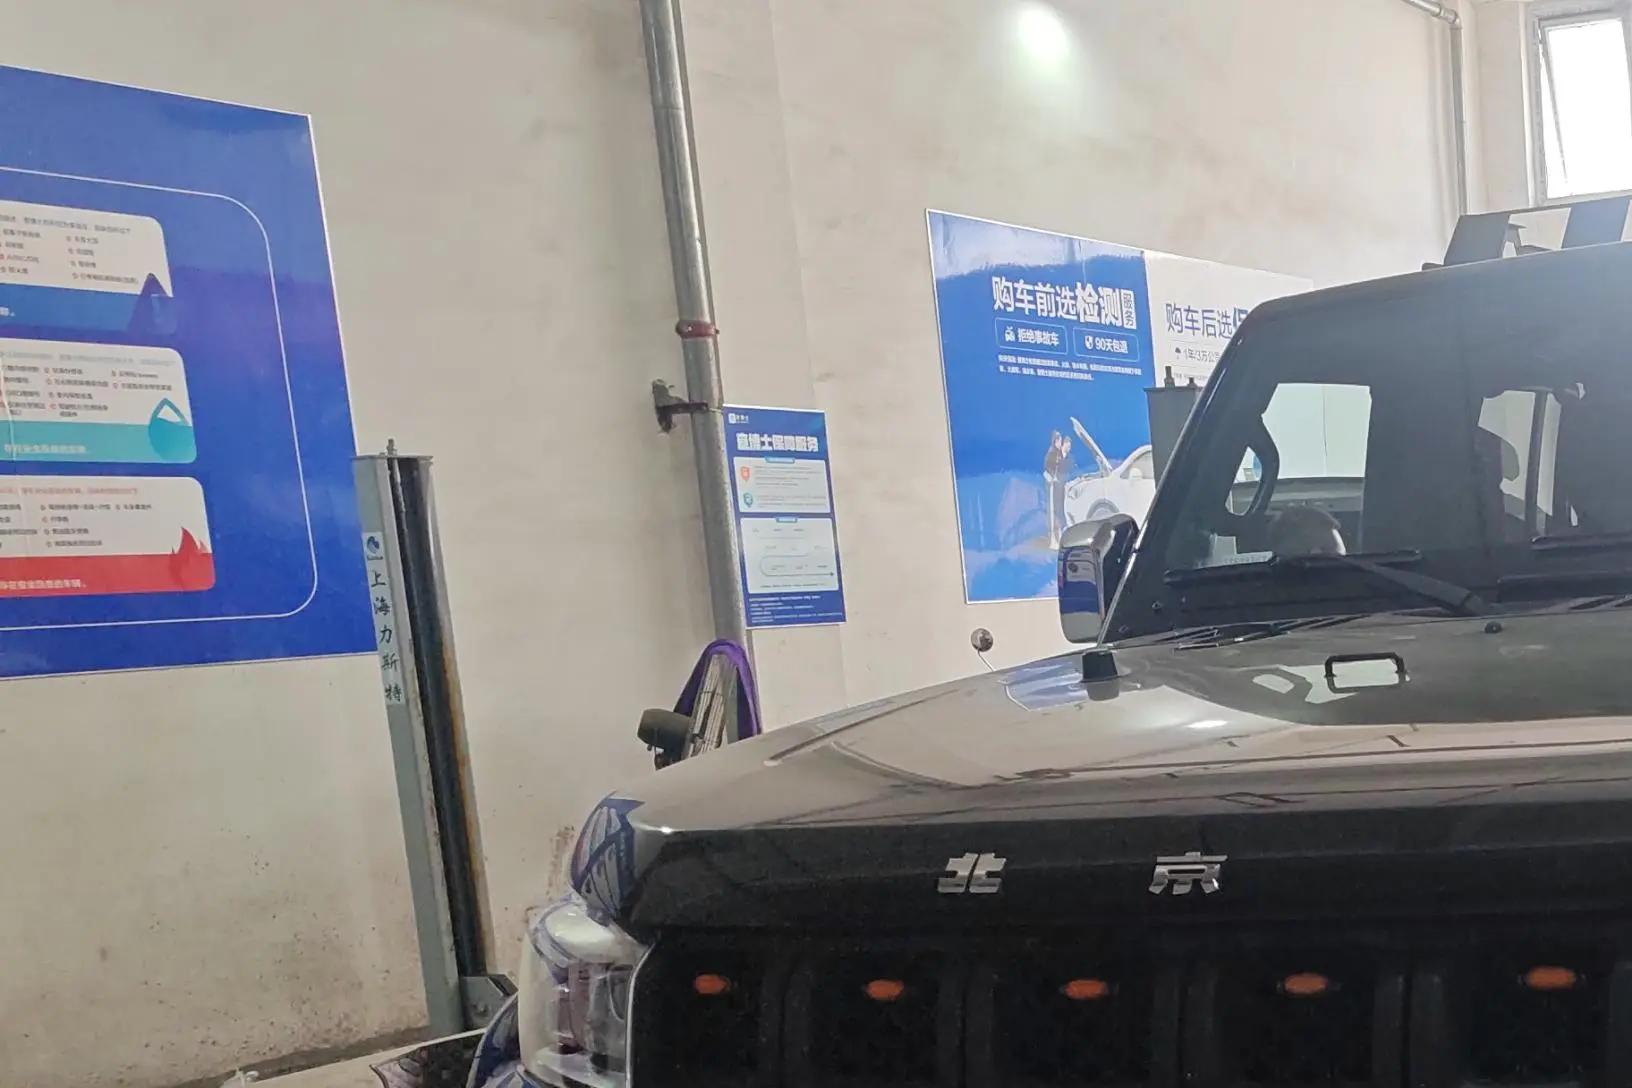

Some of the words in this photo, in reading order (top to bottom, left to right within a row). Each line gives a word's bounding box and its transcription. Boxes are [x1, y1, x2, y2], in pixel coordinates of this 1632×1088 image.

[991, 275, 1123, 328] 购车前选检测
[370, 570, 403, 702] 上海力斯特
[937, 850, 1229, 895] 北京
